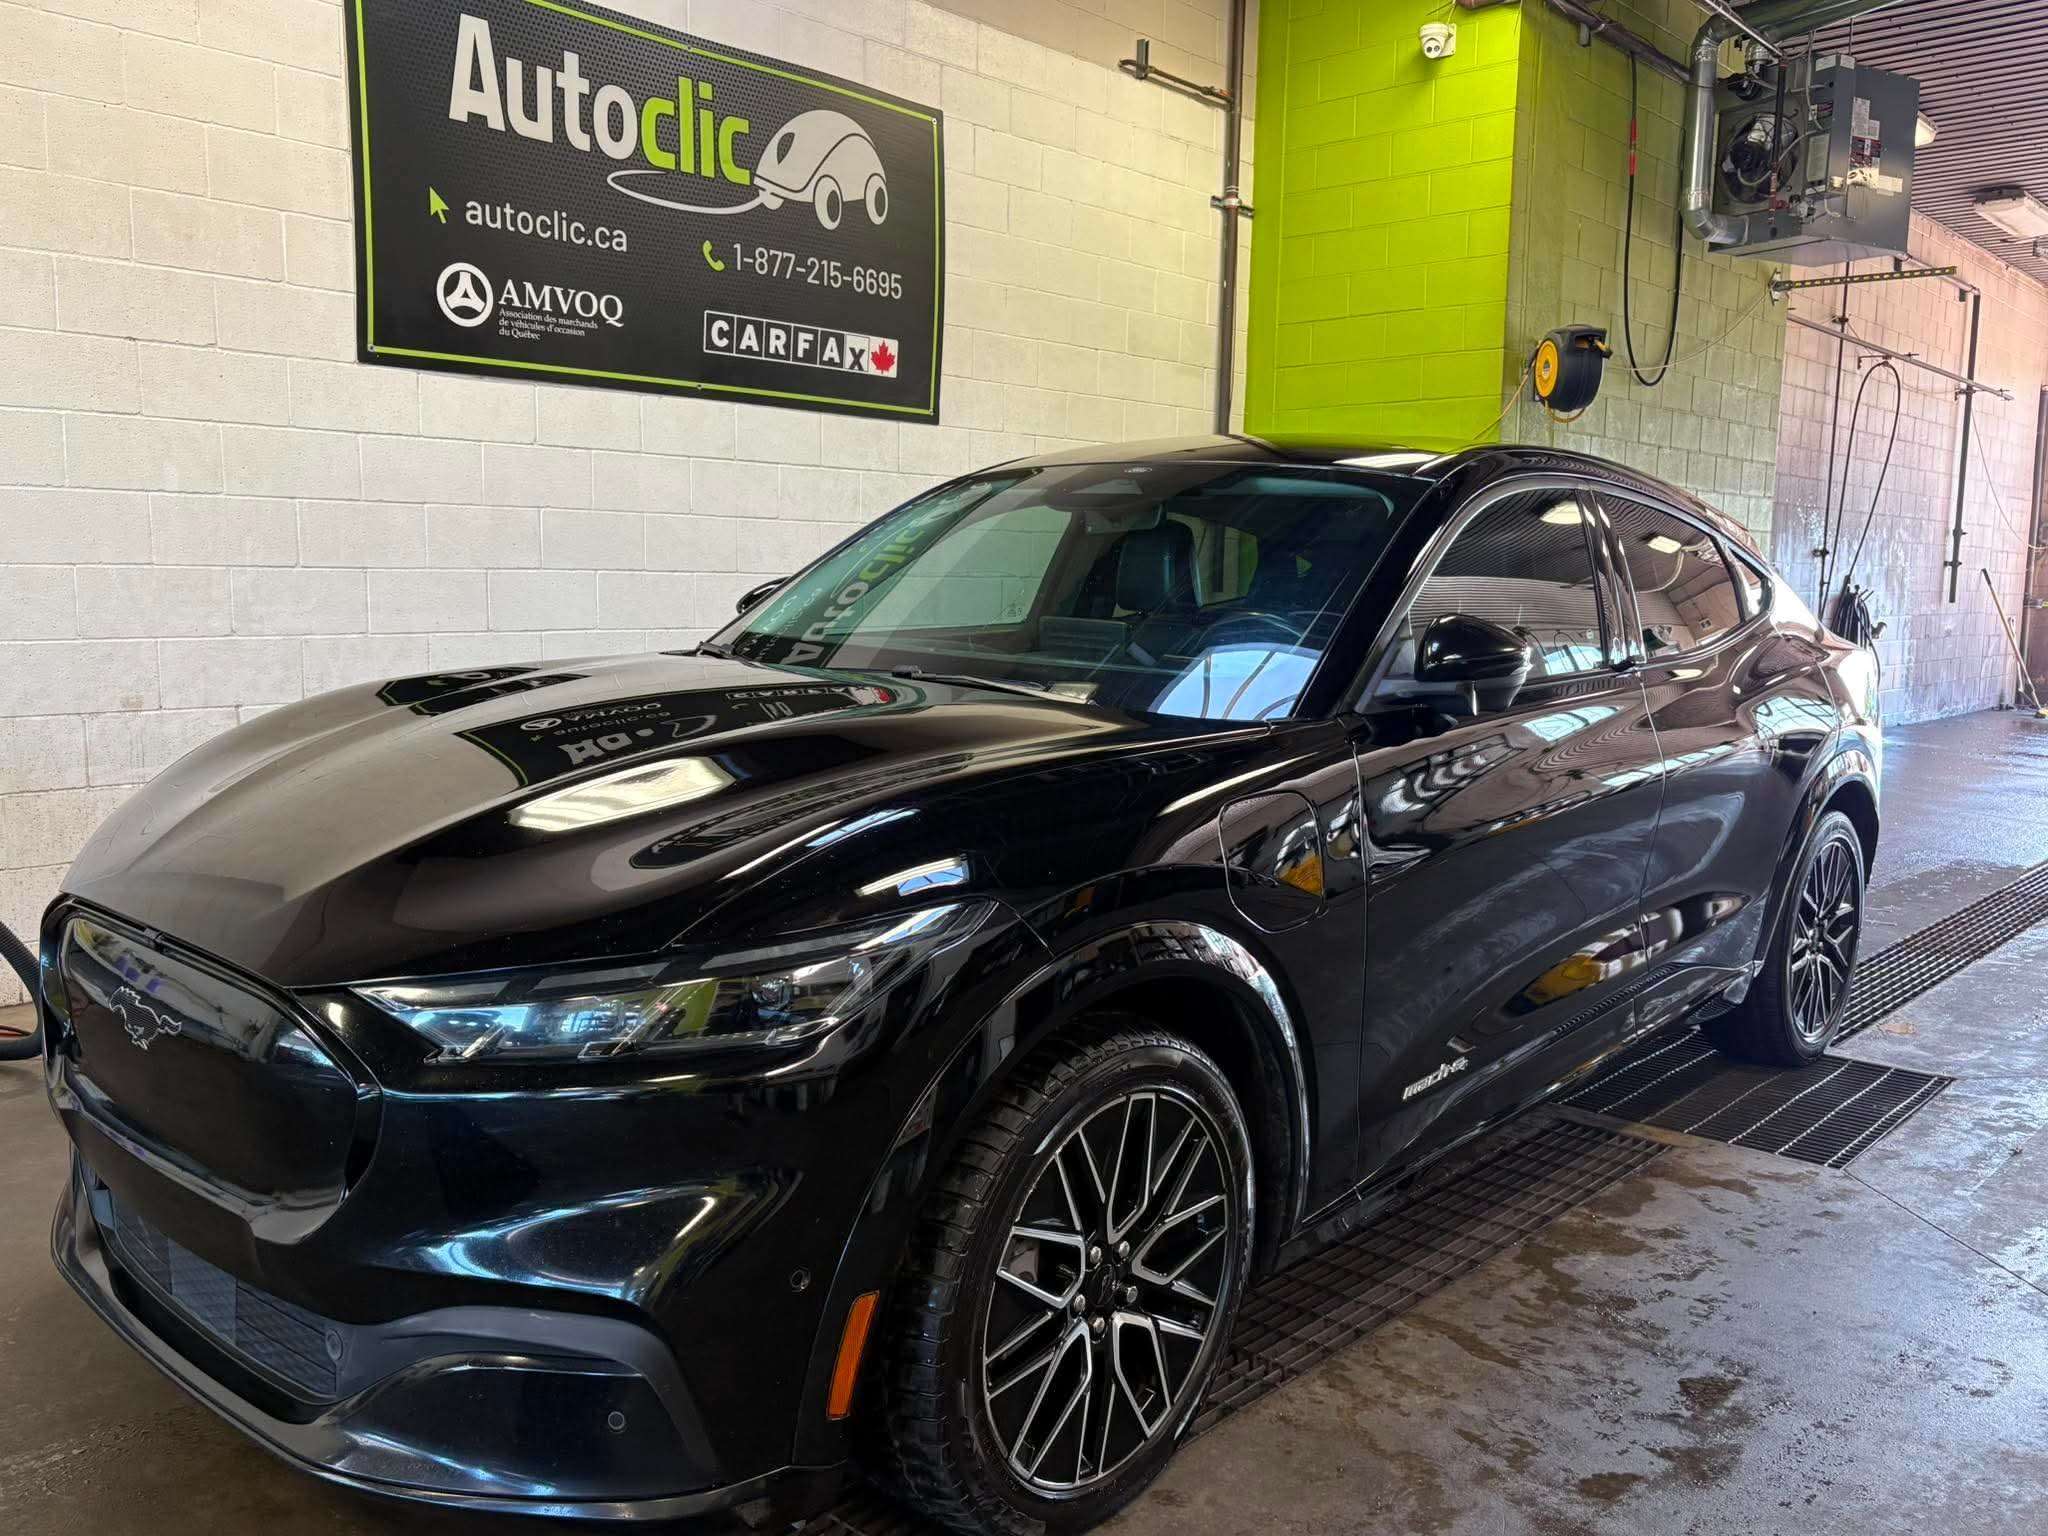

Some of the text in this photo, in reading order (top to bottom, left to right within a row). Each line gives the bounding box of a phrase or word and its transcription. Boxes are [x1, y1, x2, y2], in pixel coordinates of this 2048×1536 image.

[449, 13, 750, 186] Autoclic
[465, 200, 628, 252] autoclic.ca
[733, 243, 902, 300] 1-877-215-6695
[498, 279, 624, 327] AMVOQ
[499, 308, 599, 329] Association des marchands
[499, 317, 586, 337] de véhicules d'occasion
[499, 327, 542, 340] du Québec
[710, 319, 866, 372] CARFAX
